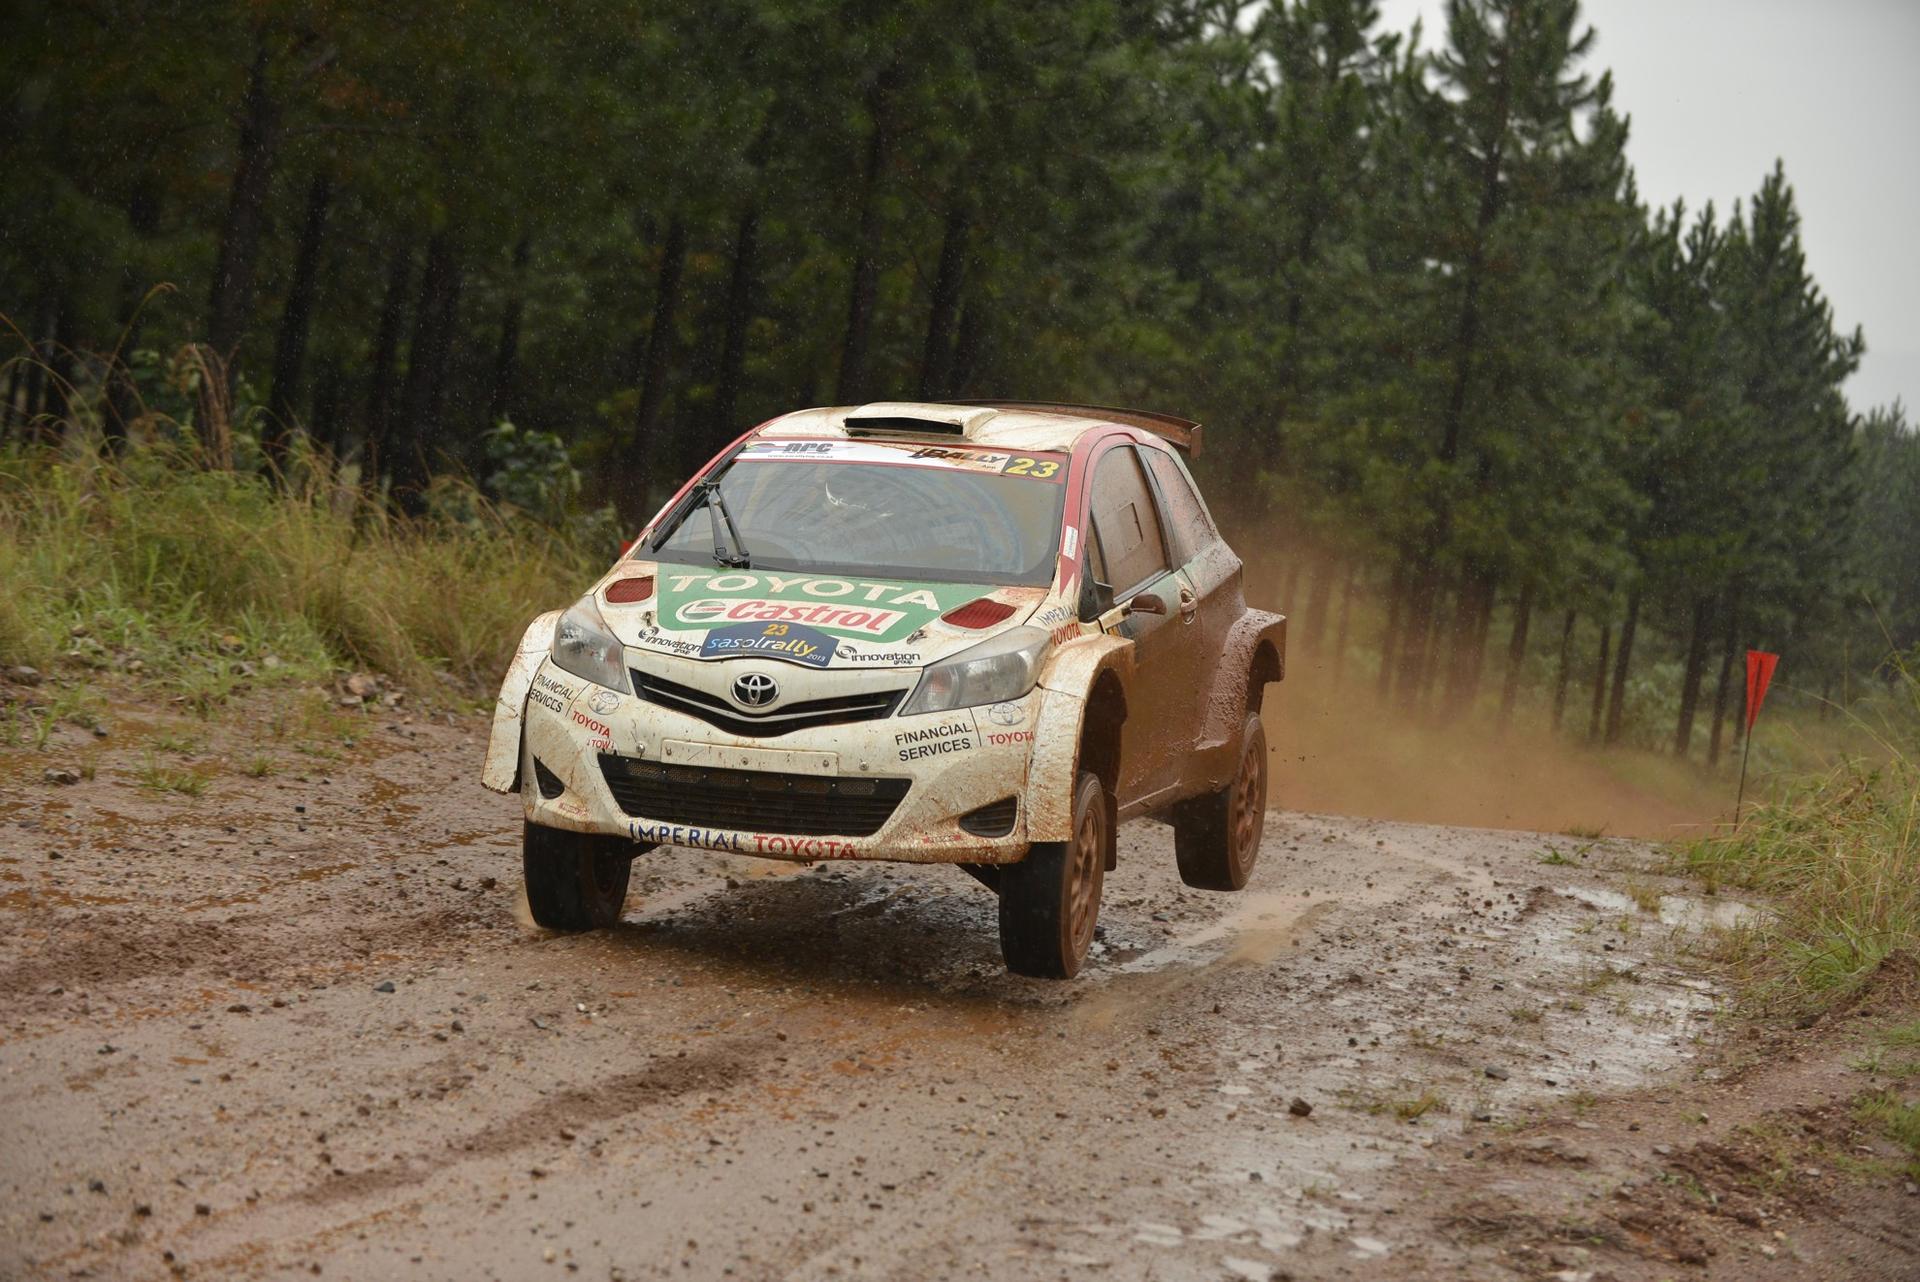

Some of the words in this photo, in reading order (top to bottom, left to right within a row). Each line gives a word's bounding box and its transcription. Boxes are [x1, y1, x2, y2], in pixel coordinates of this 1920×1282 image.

[1005, 457, 1060, 478] 23
[669, 574, 941, 612] TOYOTA
[727, 600, 893, 631] Castrol
[762, 624, 789, 637] 23
[645, 636, 702, 653] innovation
[673, 647, 691, 656] group
[706, 636, 818, 657] sasolrally
[806, 654, 826, 663] 2013
[851, 652, 921, 662] innovation
[893, 658, 914, 666] group
[535, 674, 574, 701] FINANCIAL
[529, 689, 564, 713] ERVICES
[572, 710, 611, 739] TOYOTA
[894, 722, 973, 746] FINANCIAL
[591, 739, 611, 749] TOW
[986, 731, 1035, 746] TOYOTA
[898, 738, 972, 762] SERVICES
[629, 822, 744, 851] IMPERIAL
[752, 834, 857, 860] TOYOTA
